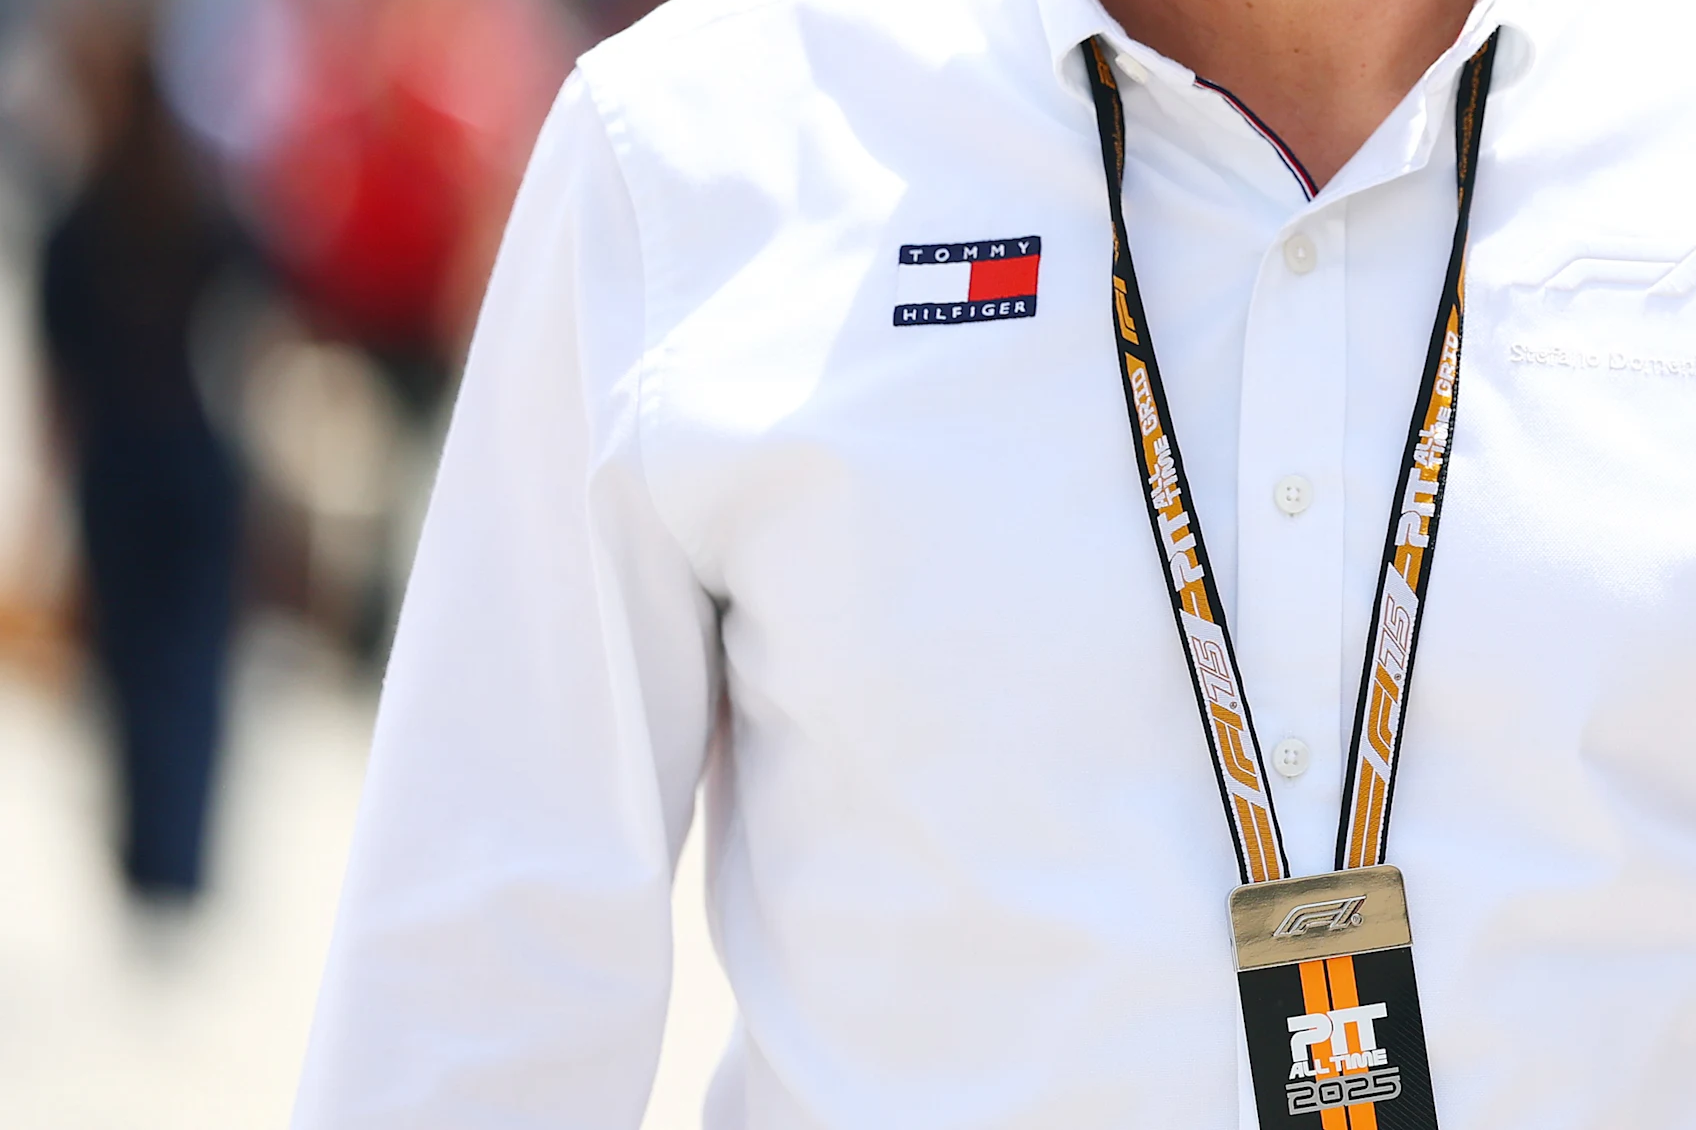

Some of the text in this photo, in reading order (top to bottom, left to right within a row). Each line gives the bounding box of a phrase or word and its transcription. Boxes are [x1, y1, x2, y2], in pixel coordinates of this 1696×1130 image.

[908, 241, 1030, 262] TOMMY
[903, 301, 1026, 321] HILFIGER
[1394, 331, 1460, 548] PIT ALL TIME GRID
[1131, 368, 1205, 592] PIT ALL TIME GRID
[1379, 595, 1411, 669] 75
[1191, 635, 1235, 702] 75
[1287, 1002, 1388, 1062] PIT
[1285, 1066, 1402, 1116] 2025
[1289, 1048, 1388, 1080] ALL TIME
